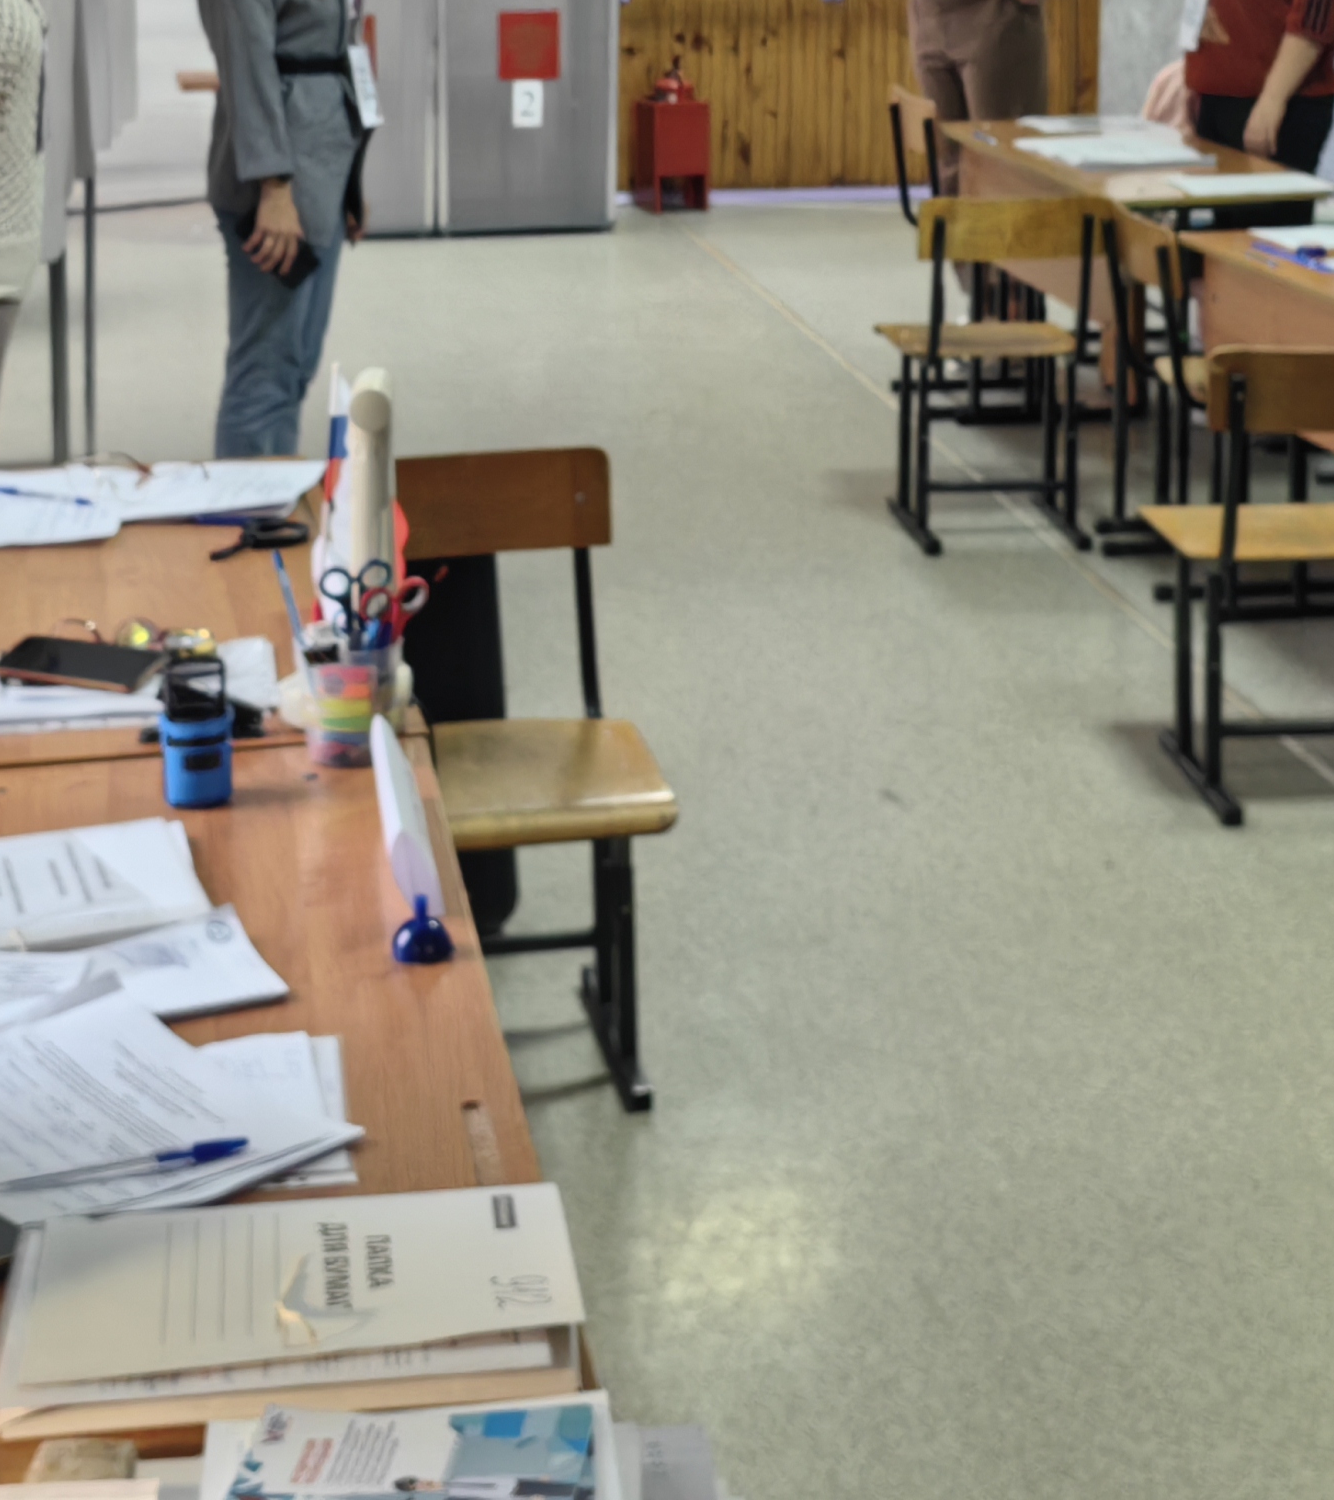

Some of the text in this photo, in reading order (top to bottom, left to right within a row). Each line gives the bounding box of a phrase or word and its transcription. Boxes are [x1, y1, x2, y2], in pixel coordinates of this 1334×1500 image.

[520, 90, 535, 118] 2
[317, 1222, 353, 1307] ДЛЯ БУМАГ
[366, 1234, 395, 1288] ПАПКА
